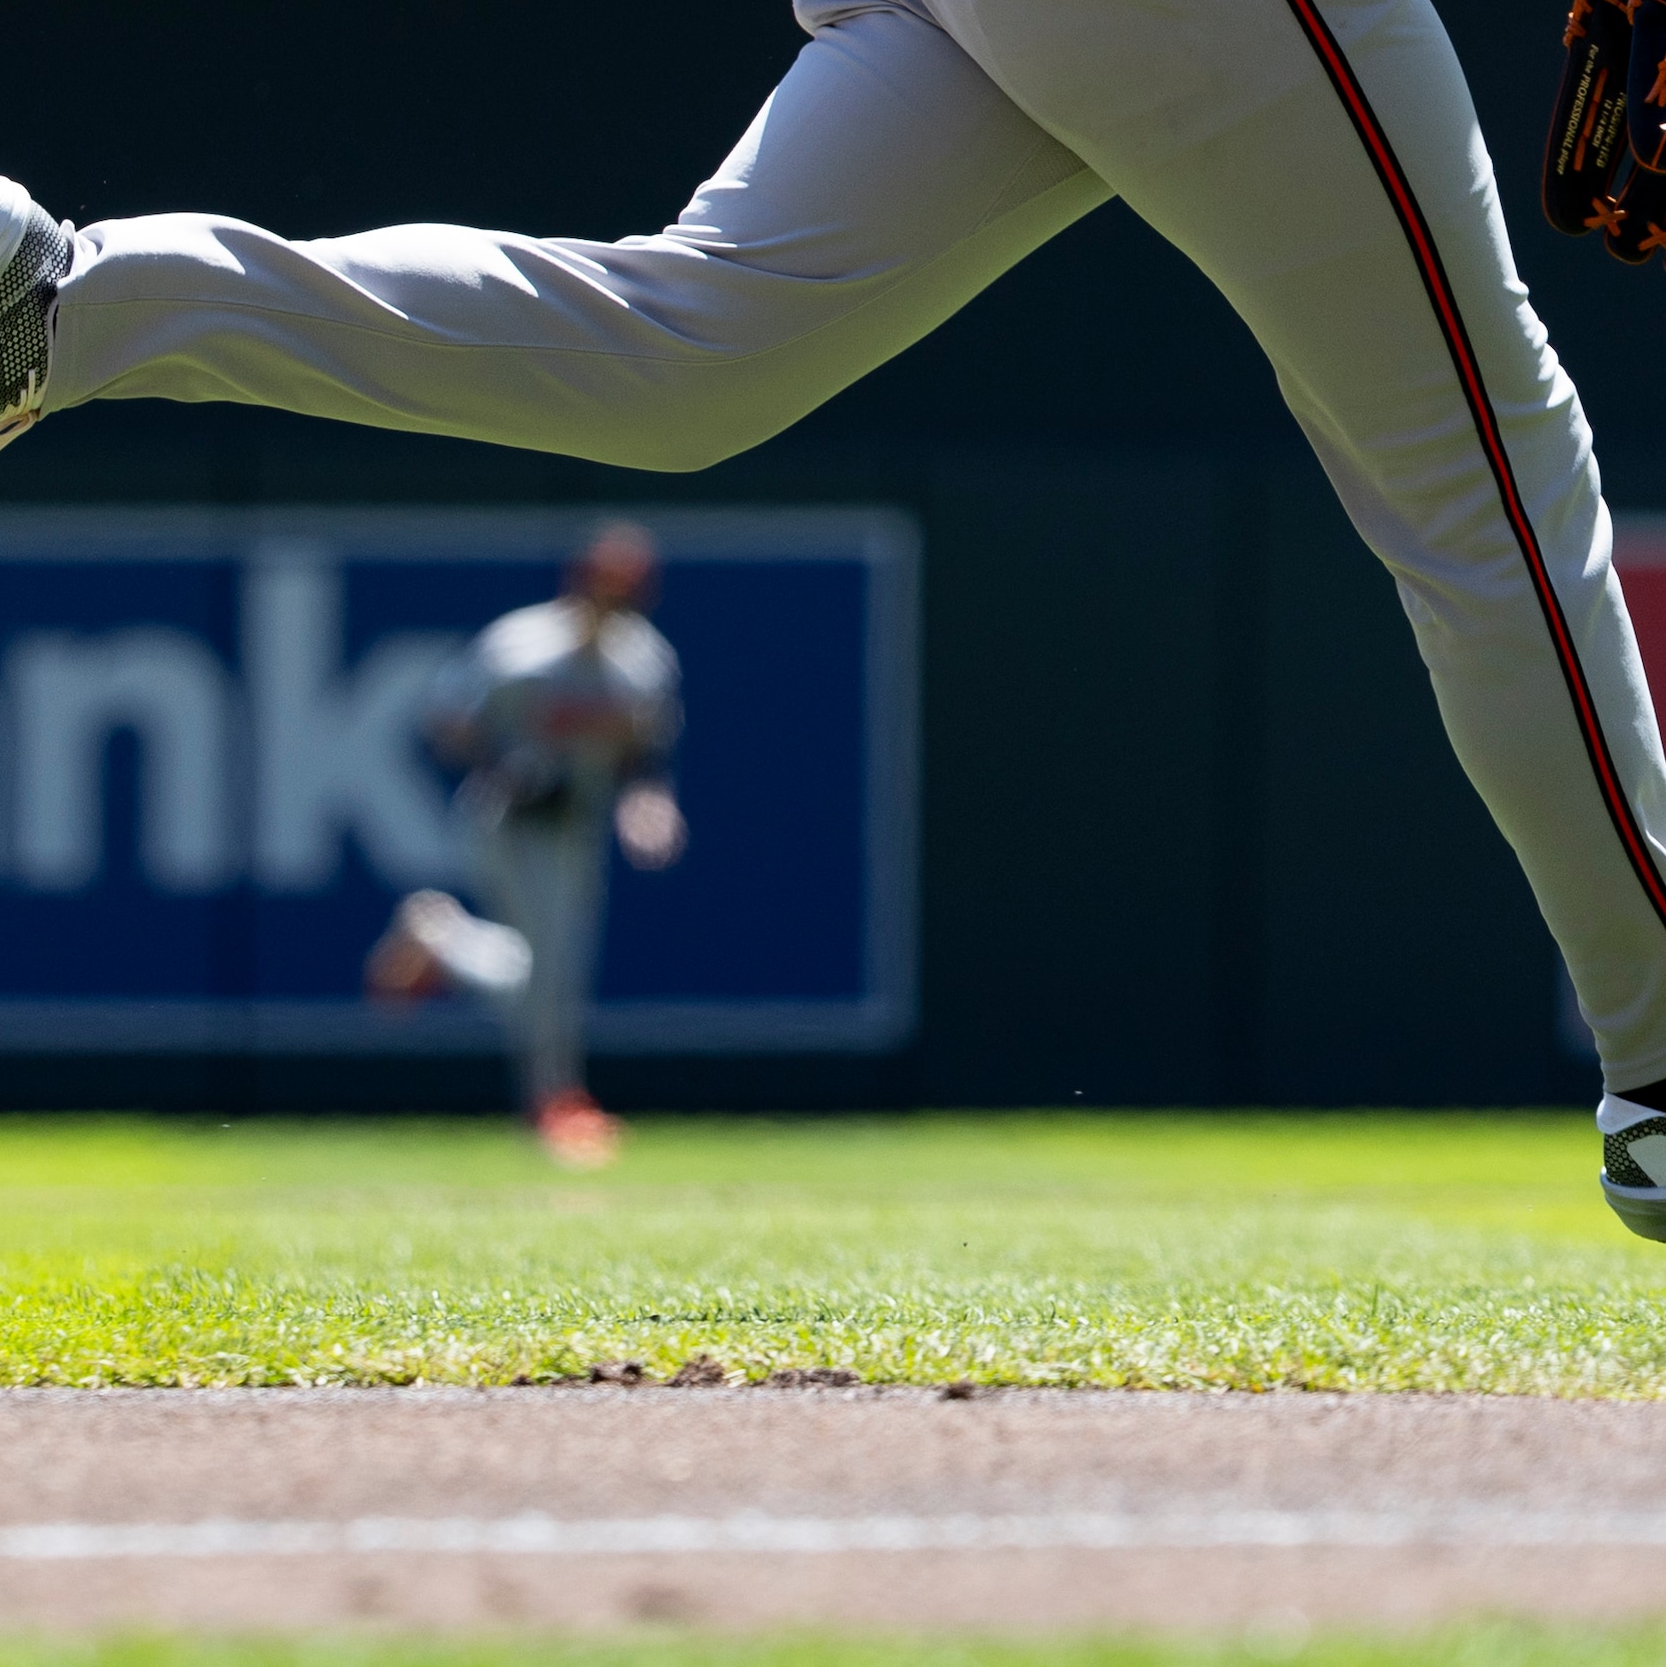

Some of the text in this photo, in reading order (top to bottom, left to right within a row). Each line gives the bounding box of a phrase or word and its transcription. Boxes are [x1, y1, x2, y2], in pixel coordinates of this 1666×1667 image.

[1556, 44, 1600, 176] For the PROFESSIONAL player
